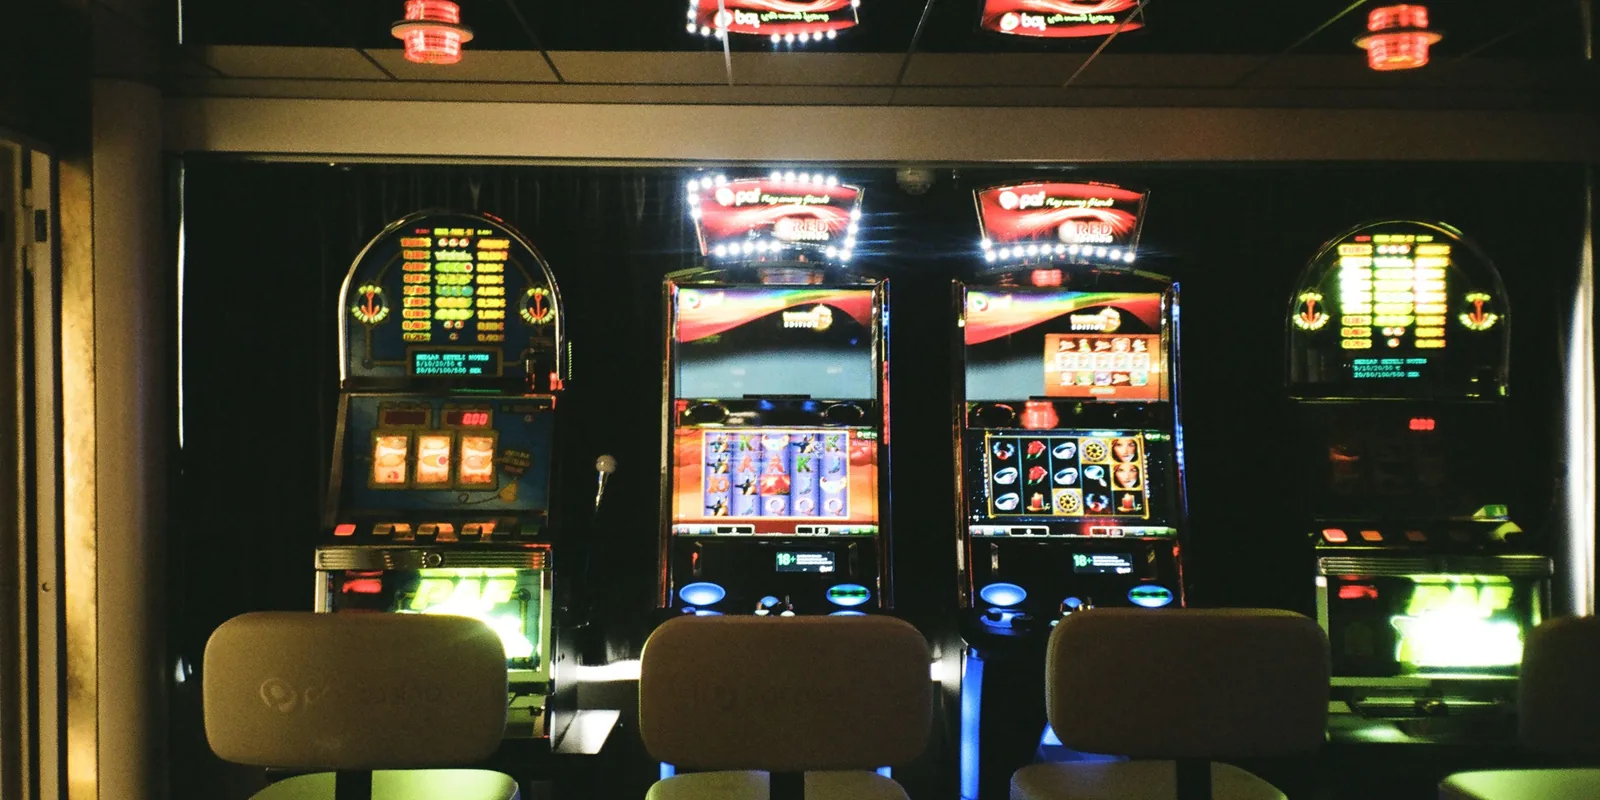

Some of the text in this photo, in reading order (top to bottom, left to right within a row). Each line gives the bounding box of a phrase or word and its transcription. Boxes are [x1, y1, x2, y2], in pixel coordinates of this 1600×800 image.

[792, 219, 829, 233] RED
[1076, 221, 1112, 236] RED
[796, 456, 813, 473] K
[765, 498, 785, 516] Q
[795, 498, 815, 516] Q
[824, 498, 843, 516] Q
[777, 553, 796, 566] 18+
[1073, 554, 1093, 567] 18+
